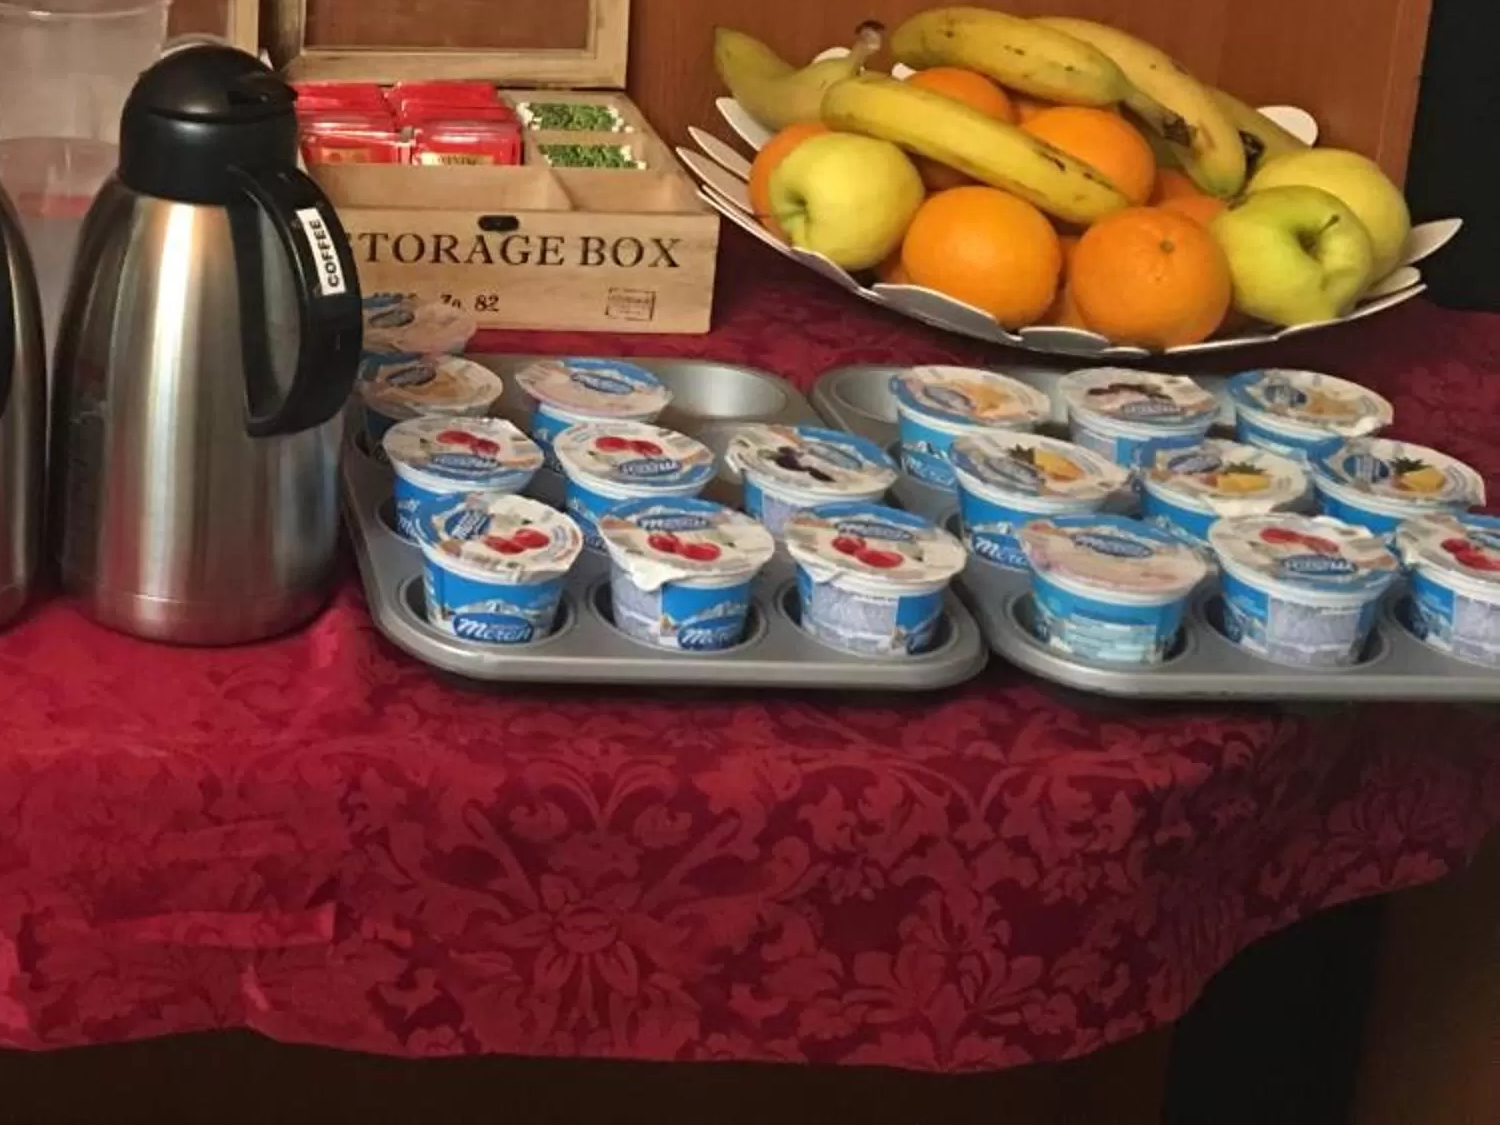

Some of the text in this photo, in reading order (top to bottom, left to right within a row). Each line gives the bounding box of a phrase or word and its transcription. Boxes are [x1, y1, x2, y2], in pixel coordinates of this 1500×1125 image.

[308, 218, 340, 288] COFFEE
[346, 232, 684, 269] TORAGE BOX
[474, 293, 500, 313] 82
